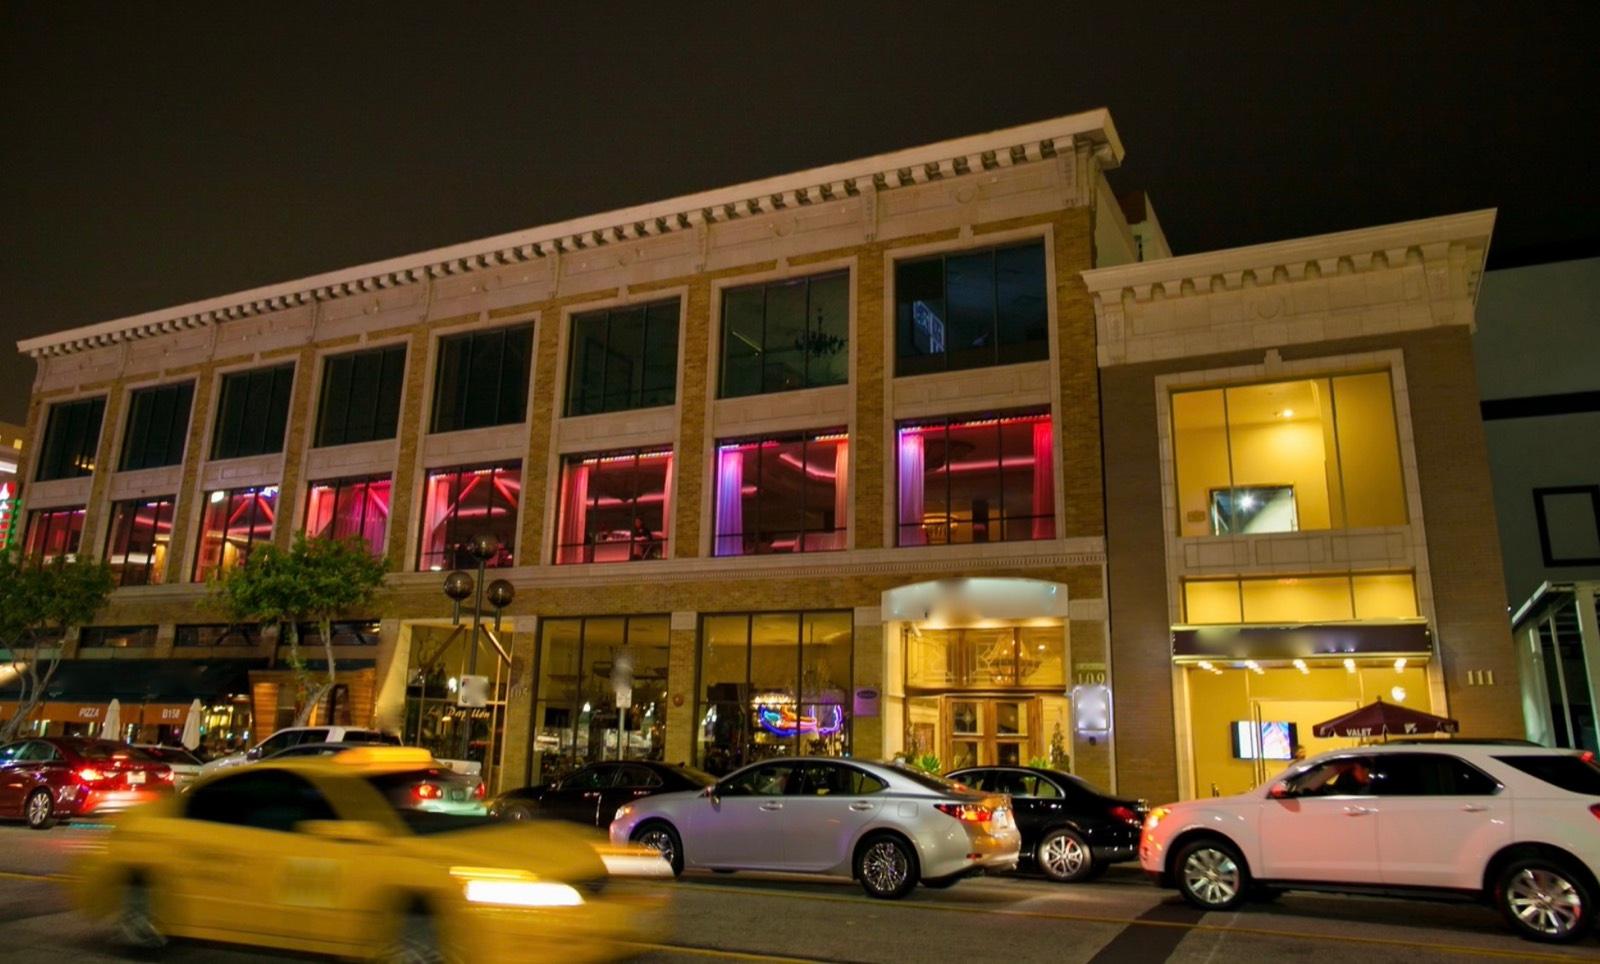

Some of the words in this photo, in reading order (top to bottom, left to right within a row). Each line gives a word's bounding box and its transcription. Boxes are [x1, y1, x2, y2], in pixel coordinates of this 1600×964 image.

[1078, 671, 1105, 687] 109
[1467, 669, 1494, 685] 111
[78, 707, 100, 718] PIZZA
[1346, 727, 1372, 737] VALET
